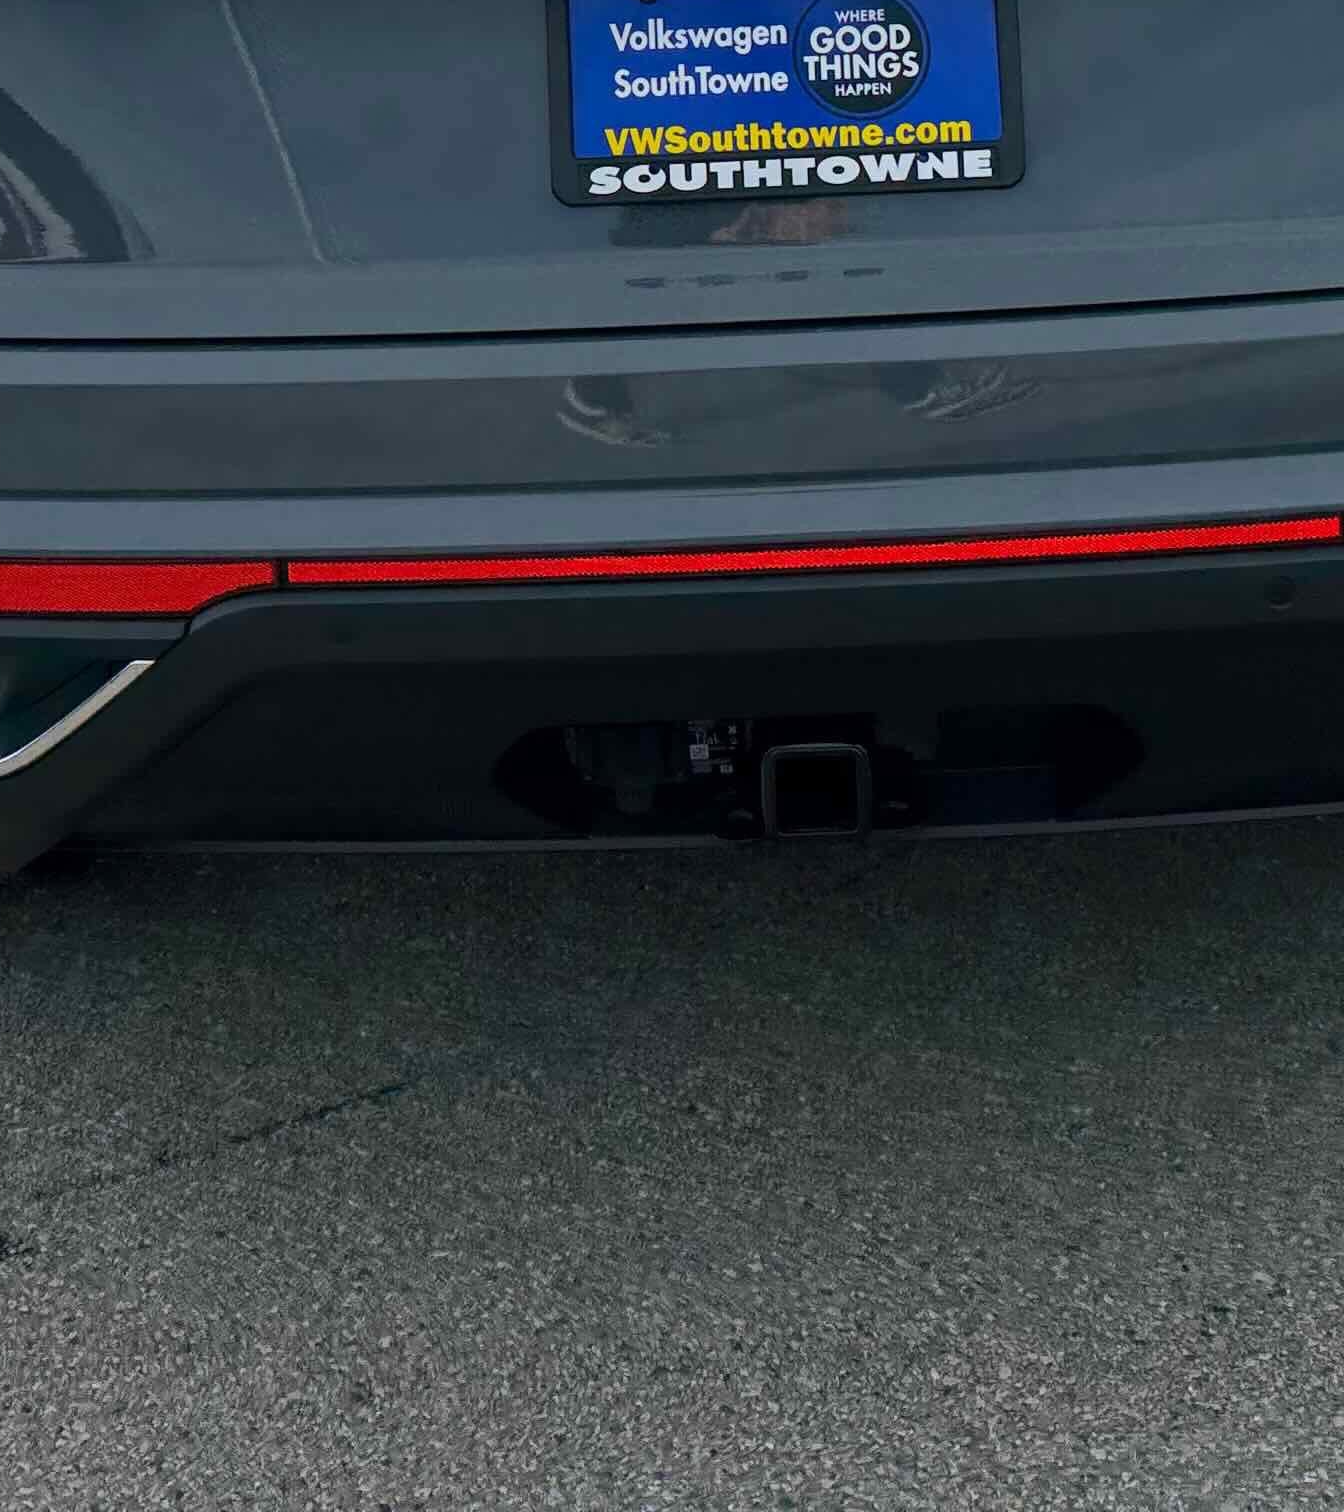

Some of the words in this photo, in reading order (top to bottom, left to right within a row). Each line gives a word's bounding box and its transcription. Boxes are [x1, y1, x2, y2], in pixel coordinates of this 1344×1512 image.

[834, 8, 886, 24] WHERE
[608, 18, 788, 55] Volkswagen
[809, 23, 911, 54] GOOD
[803, 51, 920, 81] THINGS
[834, 82, 892, 97] HAPPEN
[604, 119, 972, 157] VWSouthtowne.com
[588, 149, 995, 196] SOUTHTOWNE
